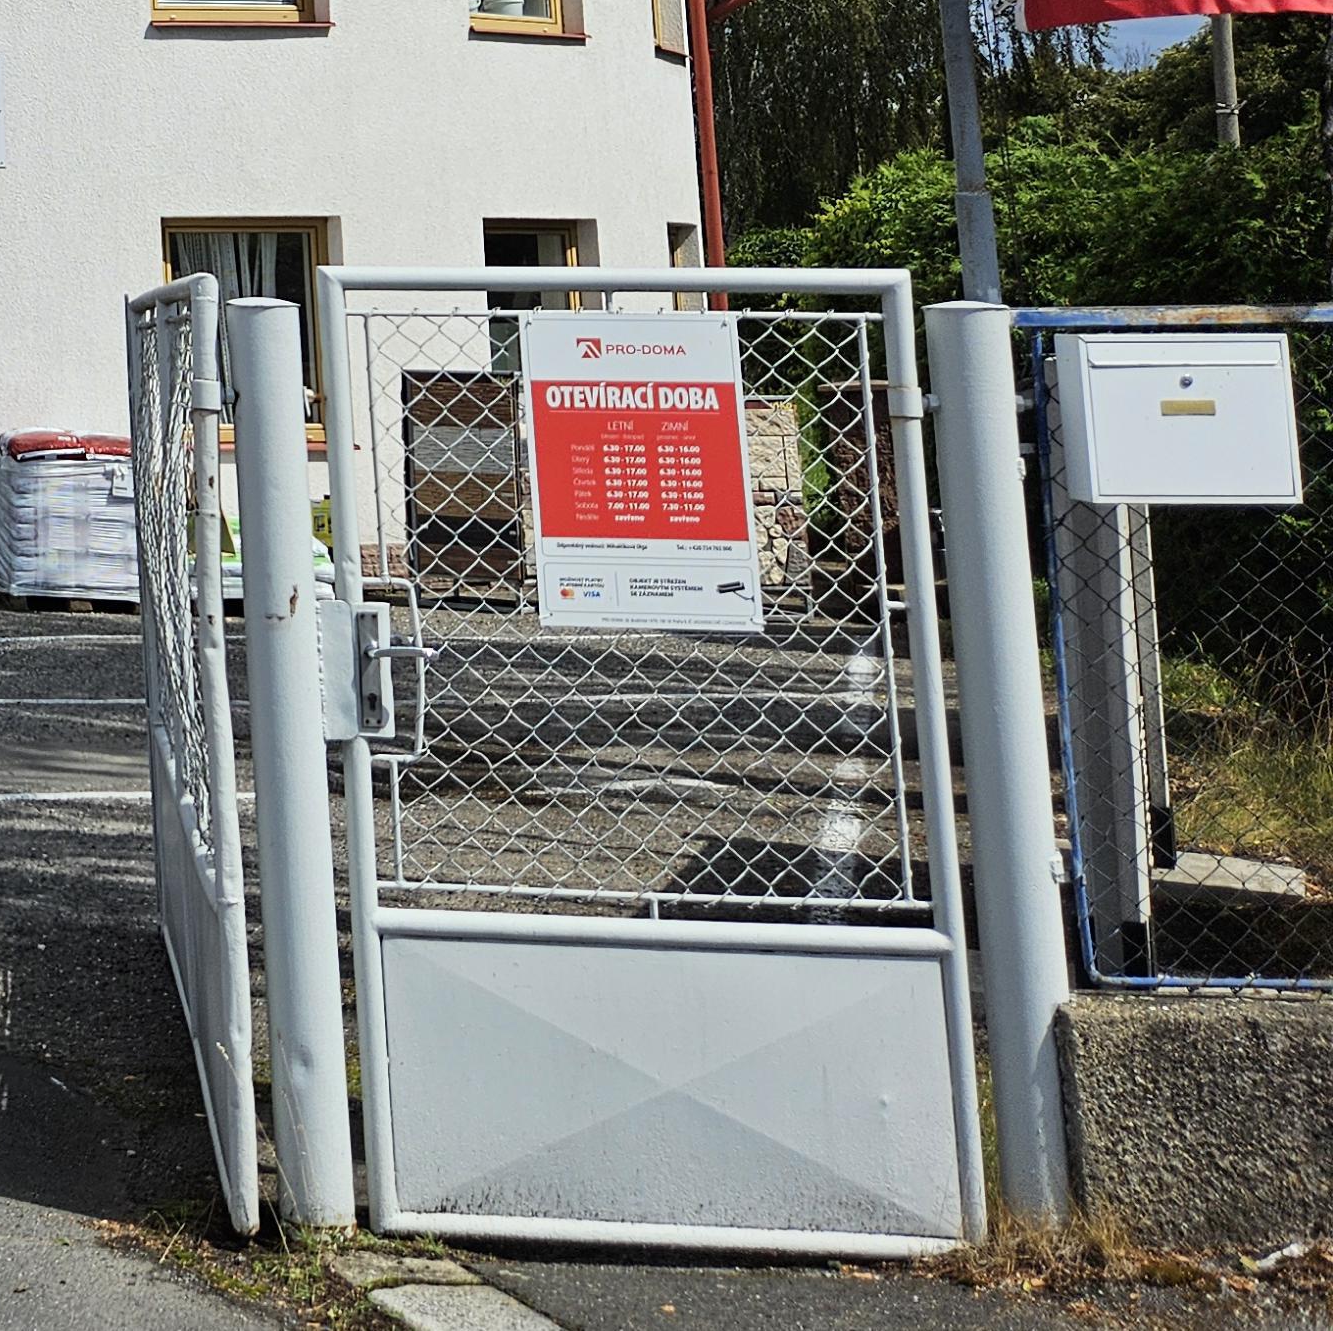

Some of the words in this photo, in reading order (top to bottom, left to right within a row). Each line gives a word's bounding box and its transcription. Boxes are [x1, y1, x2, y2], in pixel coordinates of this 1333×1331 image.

[605, 344, 686, 356] PRO-DOMA
[545, 382, 654, 410] OTEVÍRACÍ
[659, 386, 720, 410] DOBA
[607, 421, 634, 431] LETNÍ
[661, 421, 689, 431] ZIMNÍ
